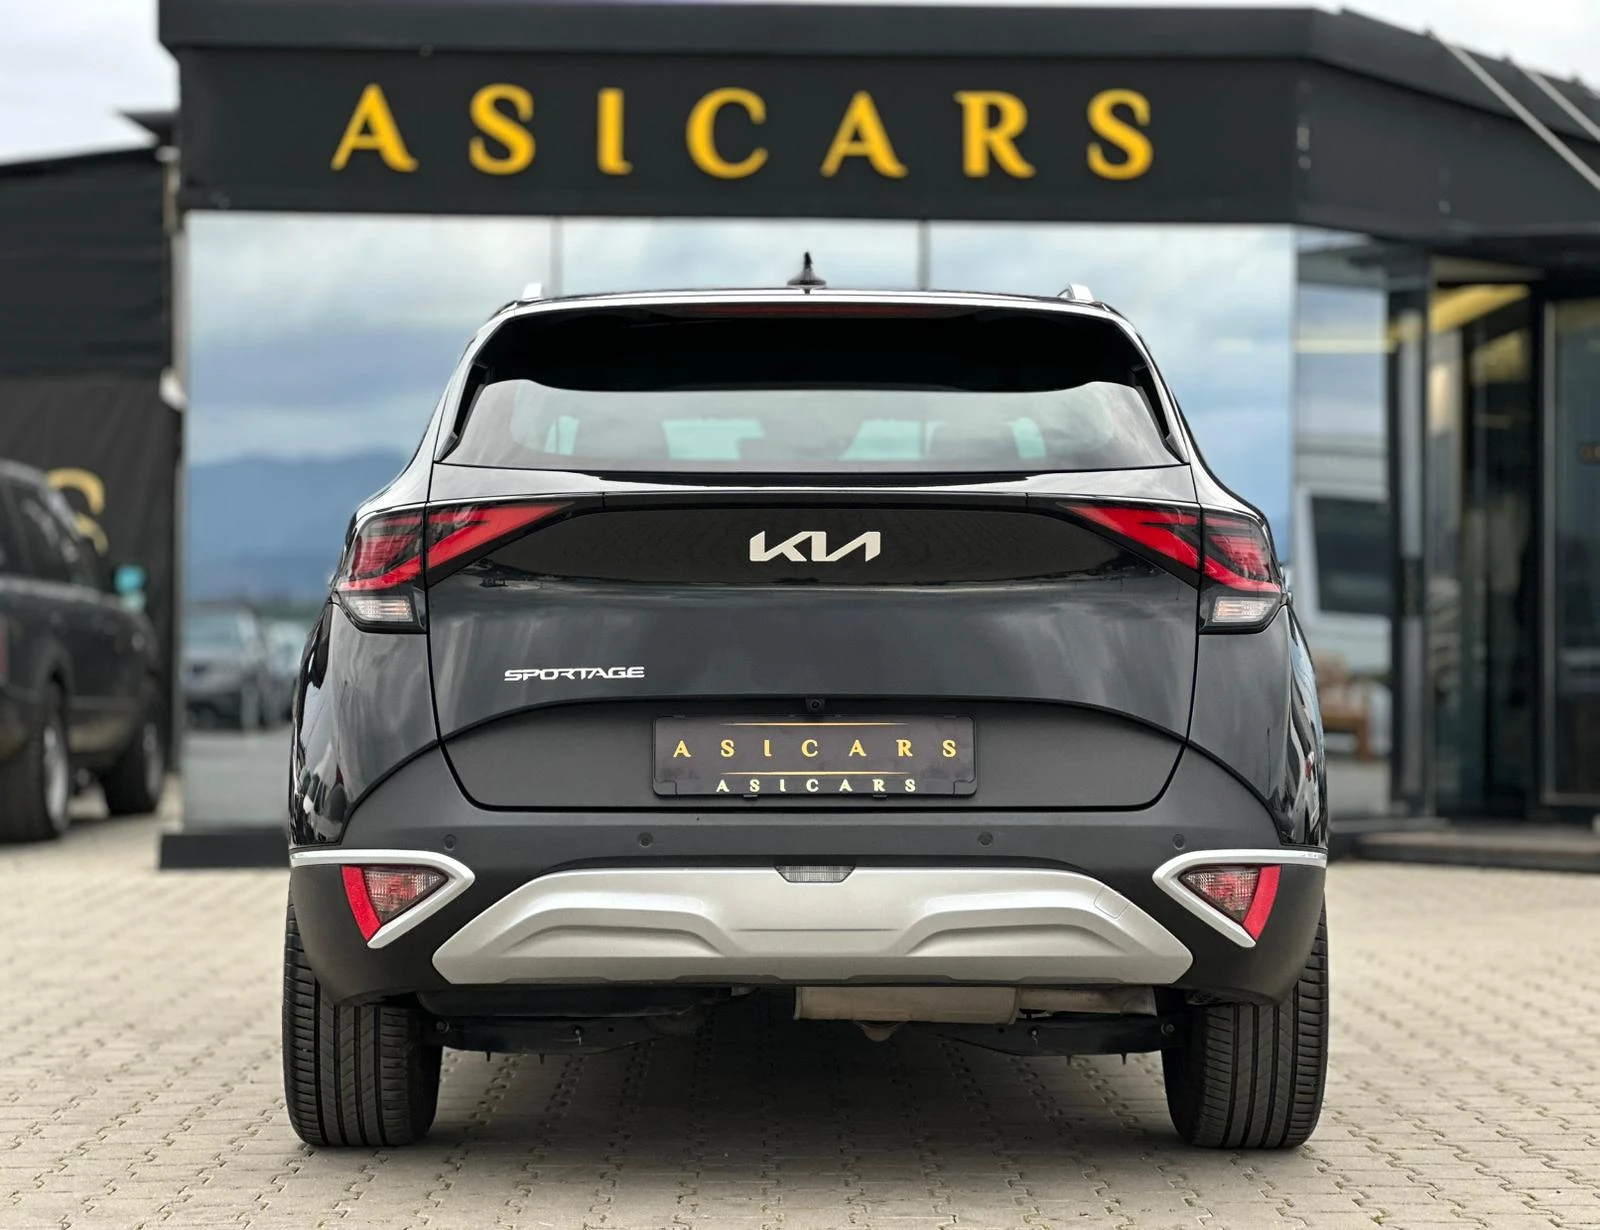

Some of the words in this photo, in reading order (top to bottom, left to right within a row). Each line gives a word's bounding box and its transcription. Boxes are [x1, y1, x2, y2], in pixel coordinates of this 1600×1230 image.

[332, 83, 1154, 180] ASICARS
[749, 530, 881, 562] KIA
[504, 666, 645, 681] SPORTAGE
[673, 739, 957, 757] ASICARS
[716, 778, 916, 793] ASICARS
